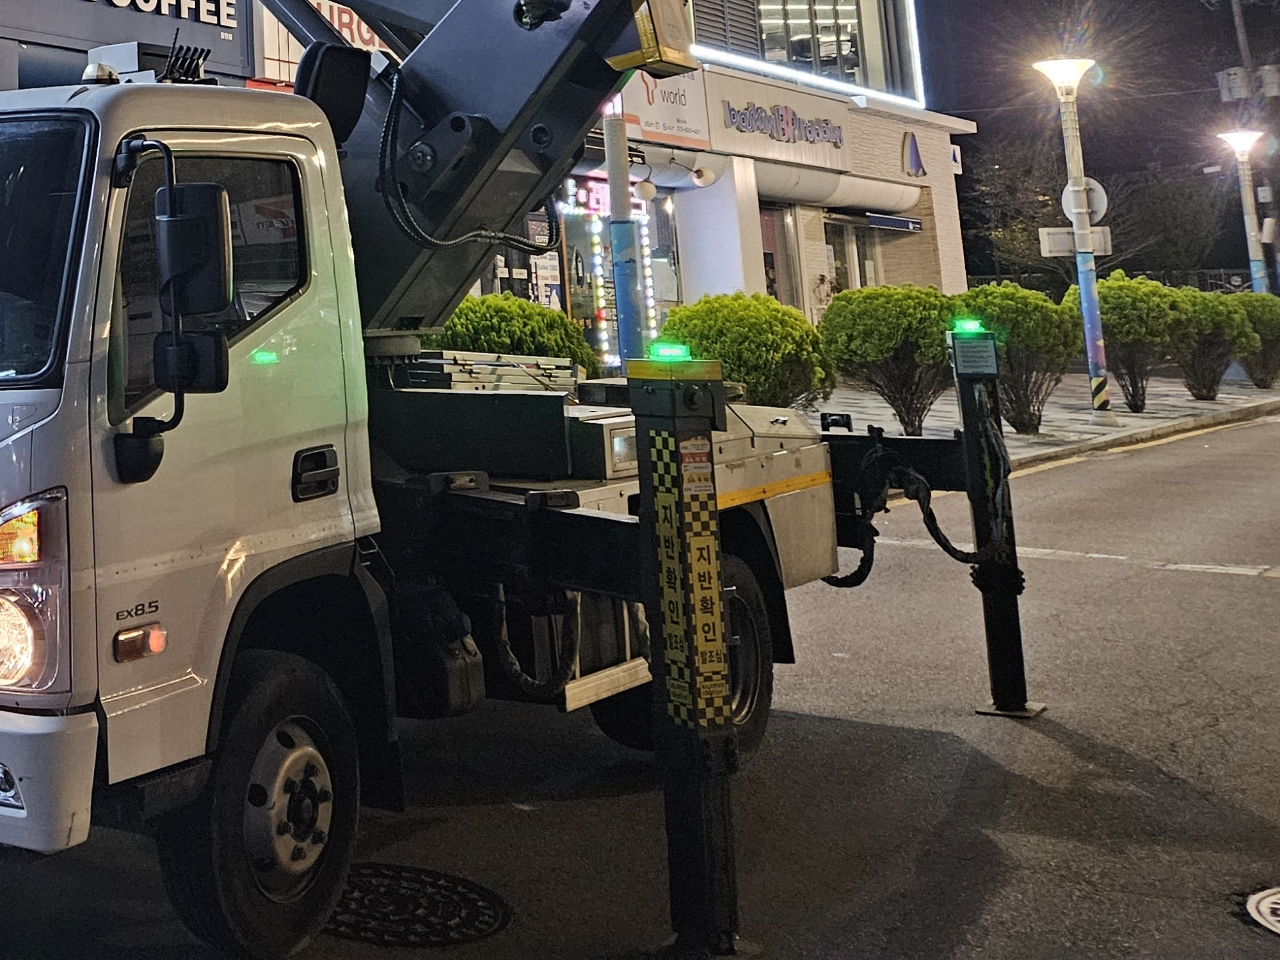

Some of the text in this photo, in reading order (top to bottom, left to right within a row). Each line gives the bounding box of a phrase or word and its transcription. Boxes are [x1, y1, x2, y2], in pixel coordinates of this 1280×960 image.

[660, 87, 687, 107] world
[661, 503, 680, 626] 지반확인
[696, 544, 718, 643] 지반확인
[115, 600, 160, 621] EX8.5
